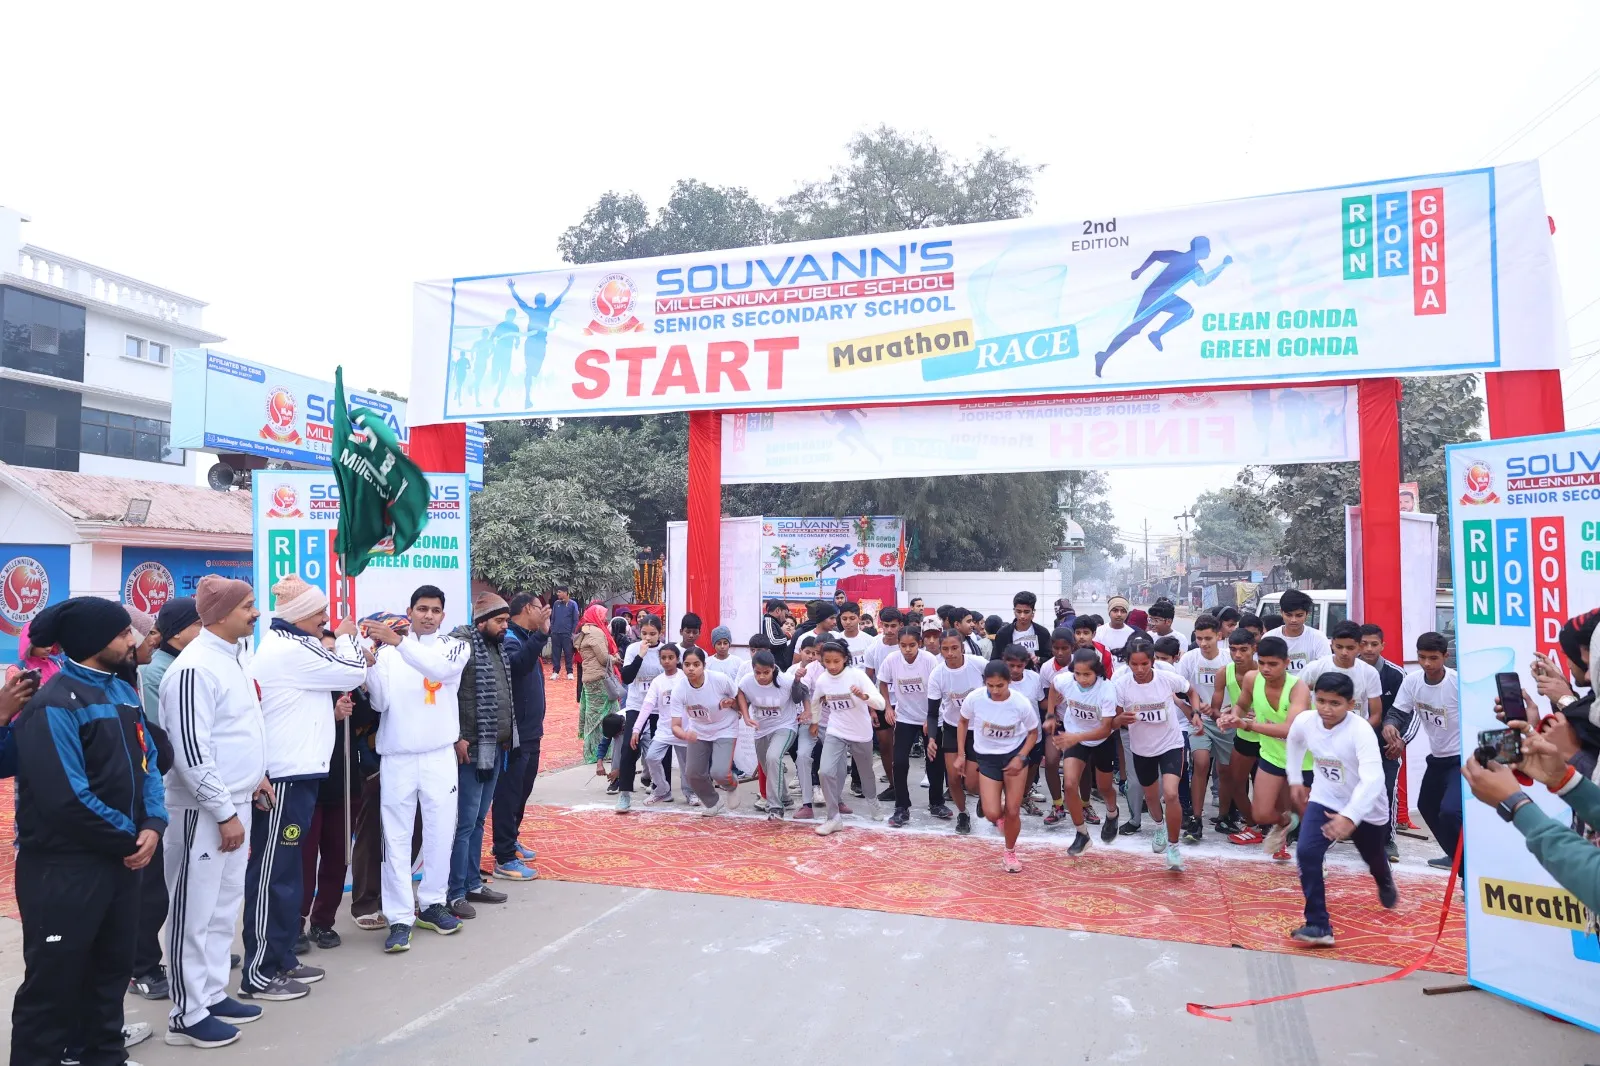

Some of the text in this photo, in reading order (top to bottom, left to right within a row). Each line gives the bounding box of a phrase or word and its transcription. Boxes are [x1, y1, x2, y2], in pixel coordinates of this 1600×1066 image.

[1082, 217, 1118, 236] 2nd
[1384, 200, 1403, 270] FOR
[1071, 235, 1130, 252] EDITION
[1349, 203, 1366, 273] RUN
[1419, 195, 1440, 309] GONDA
[655, 240, 953, 297] SOUVANN'S
[656, 275, 953, 314] MILLENNIUM PUBLIC SCHOOL
[653, 296, 955, 334] SENIOR SECONDARY SCHOOL
[1201, 308, 1359, 333] CLEAN GONDA
[832, 328, 969, 370] Marathon
[975, 328, 1074, 370] RACE
[1200, 335, 1359, 360] GREEN GONDA
[571, 335, 799, 400] START
[1507, 475, 1594, 490] MILLENNIUM
[1507, 491, 1558, 505] SENIOR
[426, 511, 460, 520] CHOOL
[777, 521, 850, 529] SOUVANN'S
[5, 558, 35, 574] MILLENNIUM
[412, 554, 459, 569] GONDA
[35, 564, 48, 584] PUBLIC
[775, 575, 813, 584] Marathon
[1469, 529, 1489, 616] RUN
[1503, 527, 1525, 617] FOR
[22, 597, 37, 605] SMPS
[37, 587, 48, 610] SCHOOL
[903, 684, 922, 693] 333
[761, 709, 779, 717] 195
[832, 700, 850, 710] 181
[1073, 708, 1094, 720] 203
[1139, 709, 1162, 722] 201
[988, 728, 1010, 738] 202
